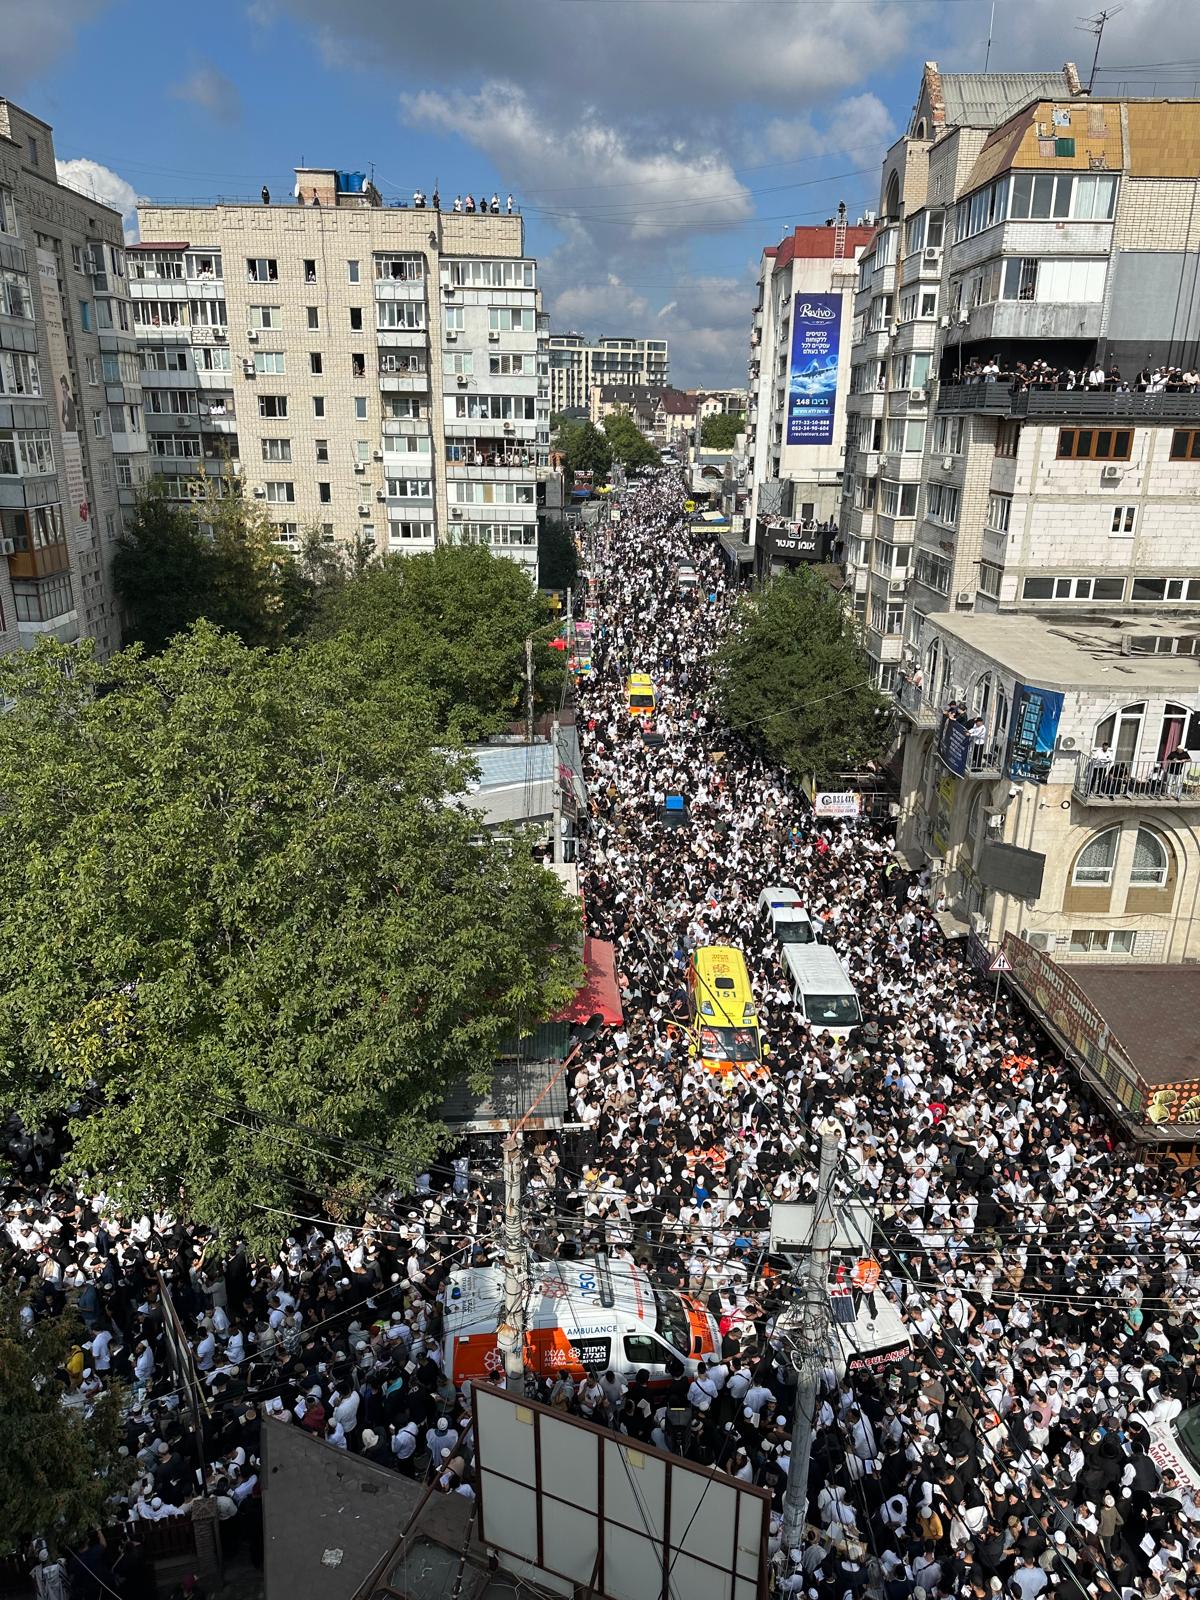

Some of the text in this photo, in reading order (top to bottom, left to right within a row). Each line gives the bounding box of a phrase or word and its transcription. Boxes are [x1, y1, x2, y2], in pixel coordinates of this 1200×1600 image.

[800, 303, 831, 318] Revivo
[776, 539, 815, 550] אומן סנטר
[1040, 960, 1064, 994] הנאמן
[716, 990, 736, 998] 151
[1066, 989, 1098, 1031] המאפה
[567, 1325, 617, 1336] AMBULANCE
